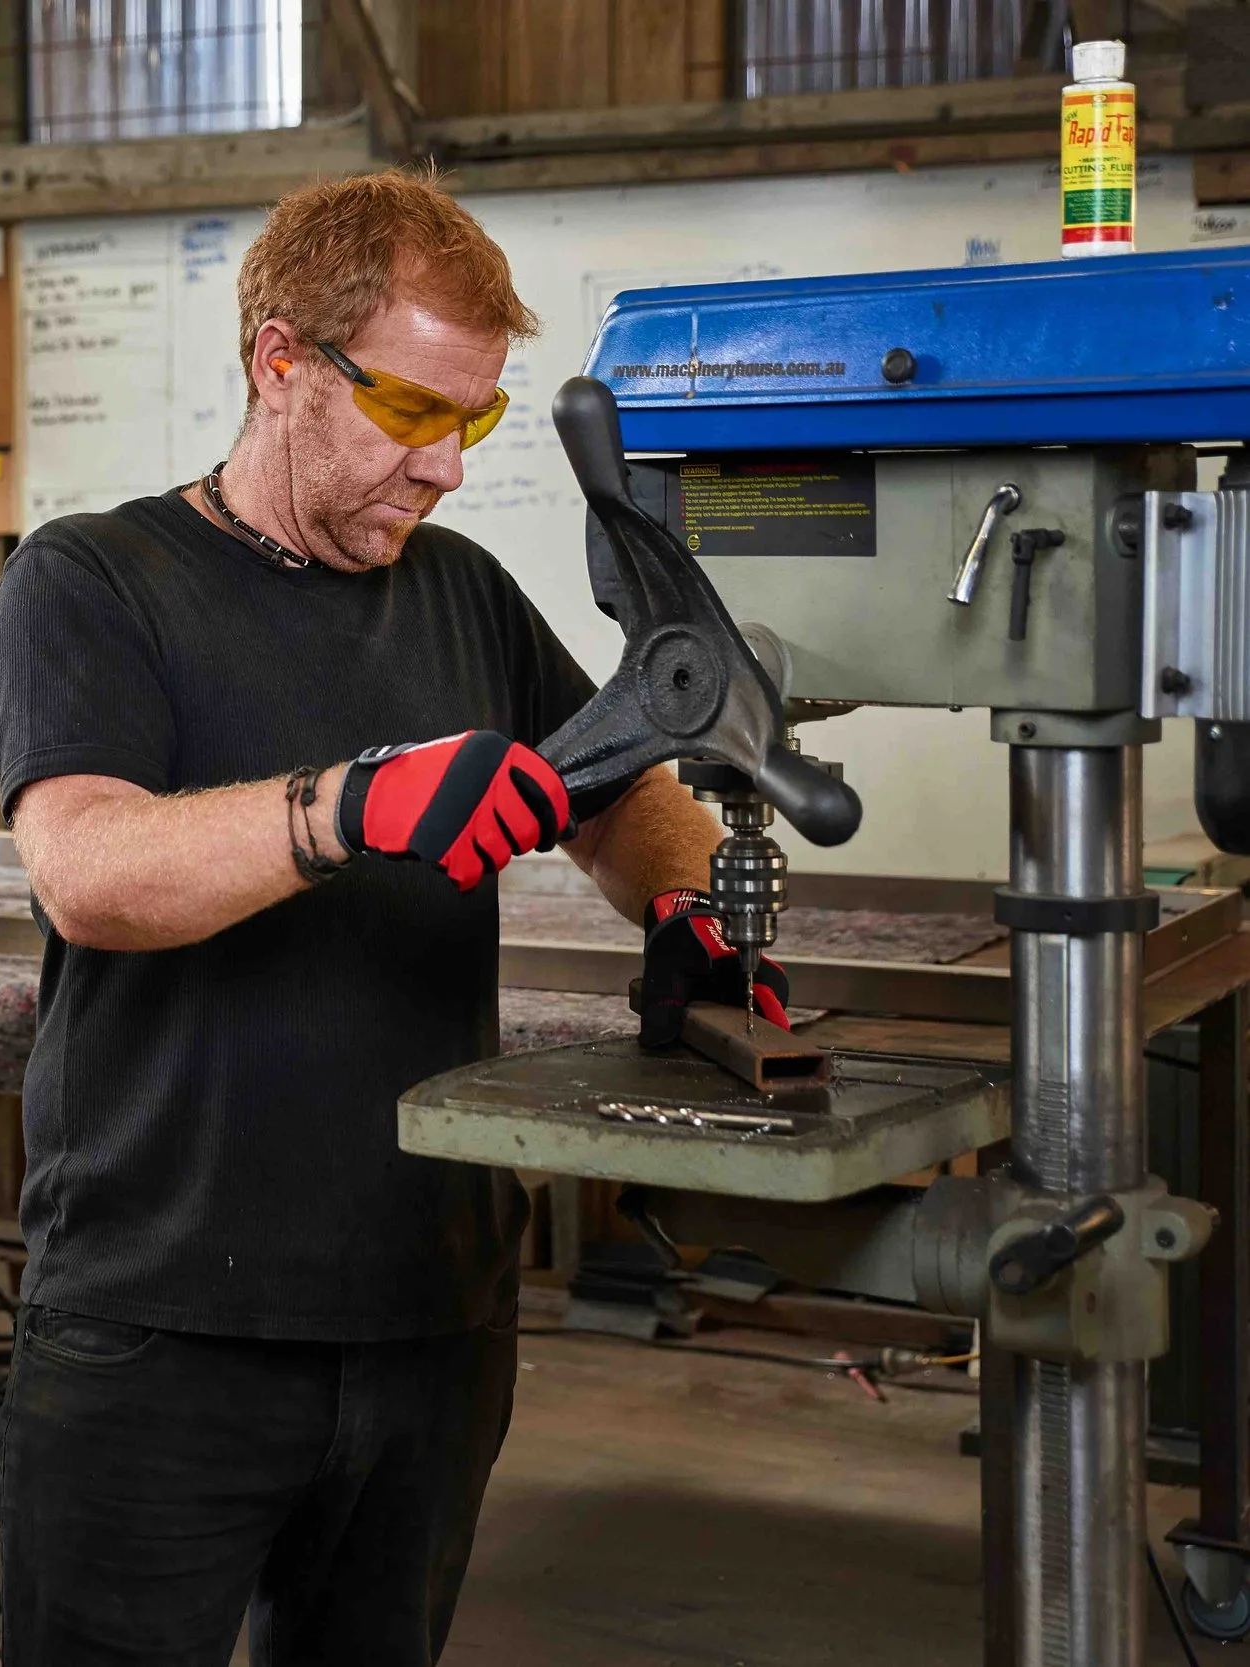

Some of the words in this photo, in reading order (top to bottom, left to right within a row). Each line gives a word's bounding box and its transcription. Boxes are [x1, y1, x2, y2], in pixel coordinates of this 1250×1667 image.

[1068, 120, 1112, 148] Rapd
[1105, 112, 1134, 148] Tap
[1063, 164, 1106, 175] CUTTING
